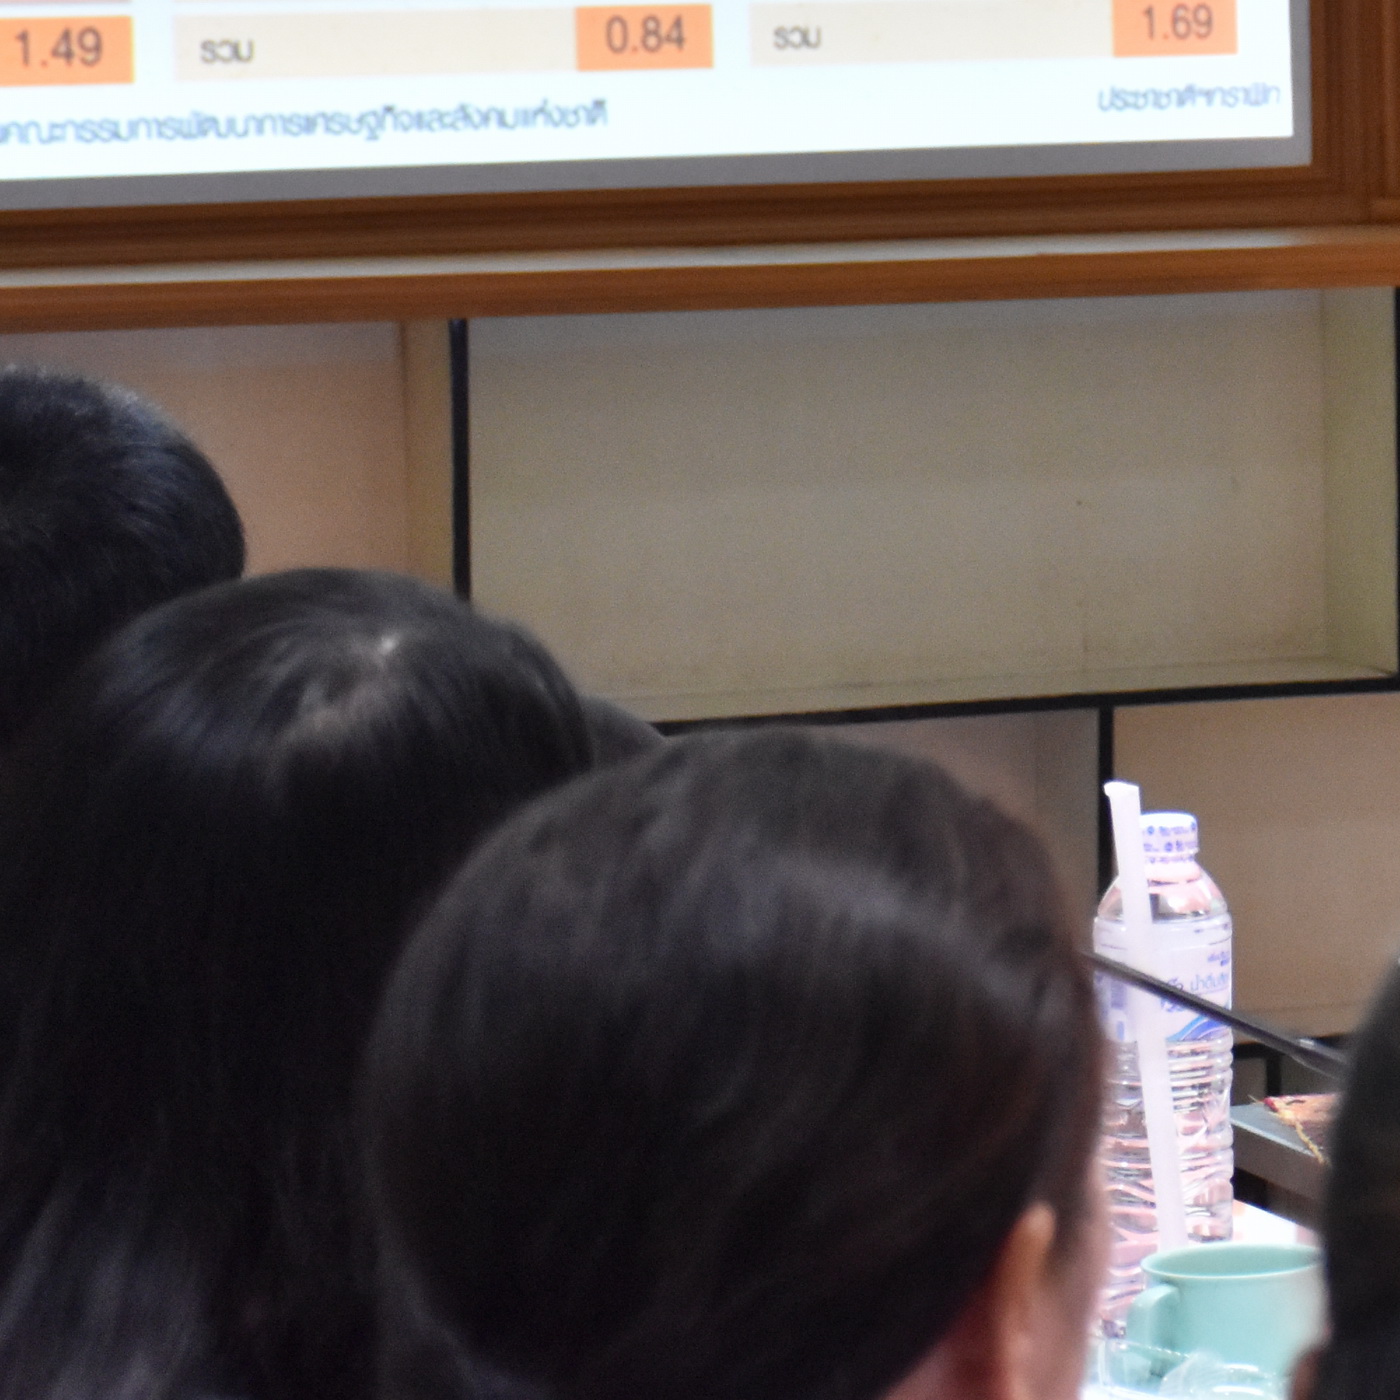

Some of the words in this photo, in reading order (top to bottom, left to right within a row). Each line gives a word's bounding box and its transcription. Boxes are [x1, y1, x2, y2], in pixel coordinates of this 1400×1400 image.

[15, 26, 103, 67] 1.49
[200, 39, 254, 64] รวม
[605, 14, 686, 54] 0.84
[773, 25, 821, 50] รวม
[1142, 2, 1213, 40] 1.69
[0, 98, 607, 143] คณะกรรมการพัฒนาการเศรษฐกิจและสังคมแห่งชาติ
